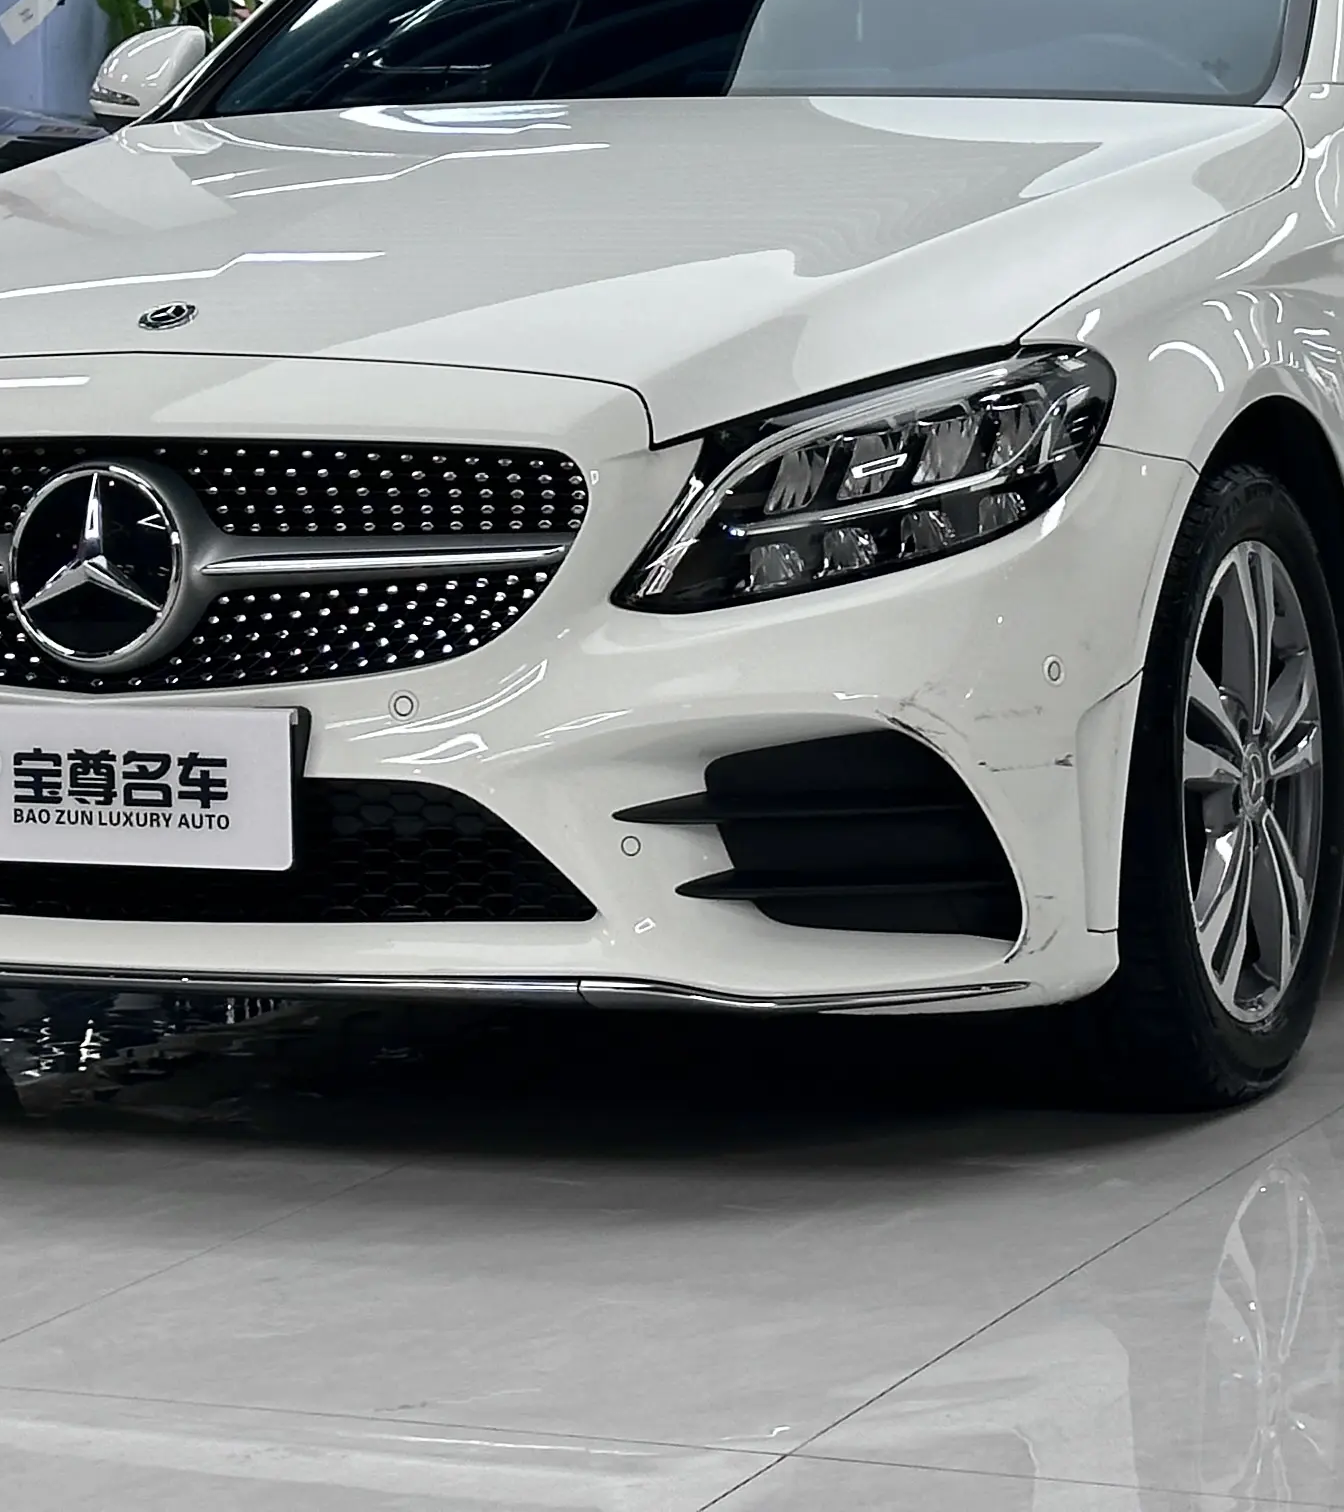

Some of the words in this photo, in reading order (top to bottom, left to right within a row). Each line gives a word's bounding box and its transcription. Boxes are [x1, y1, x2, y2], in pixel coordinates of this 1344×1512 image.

[13, 747, 229, 809] 宝尊名车
[13, 808, 51, 824] BAO
[55, 809, 93, 826] ZUN
[98, 810, 172, 828] LUXURY
[178, 813, 230, 830] AUTO
